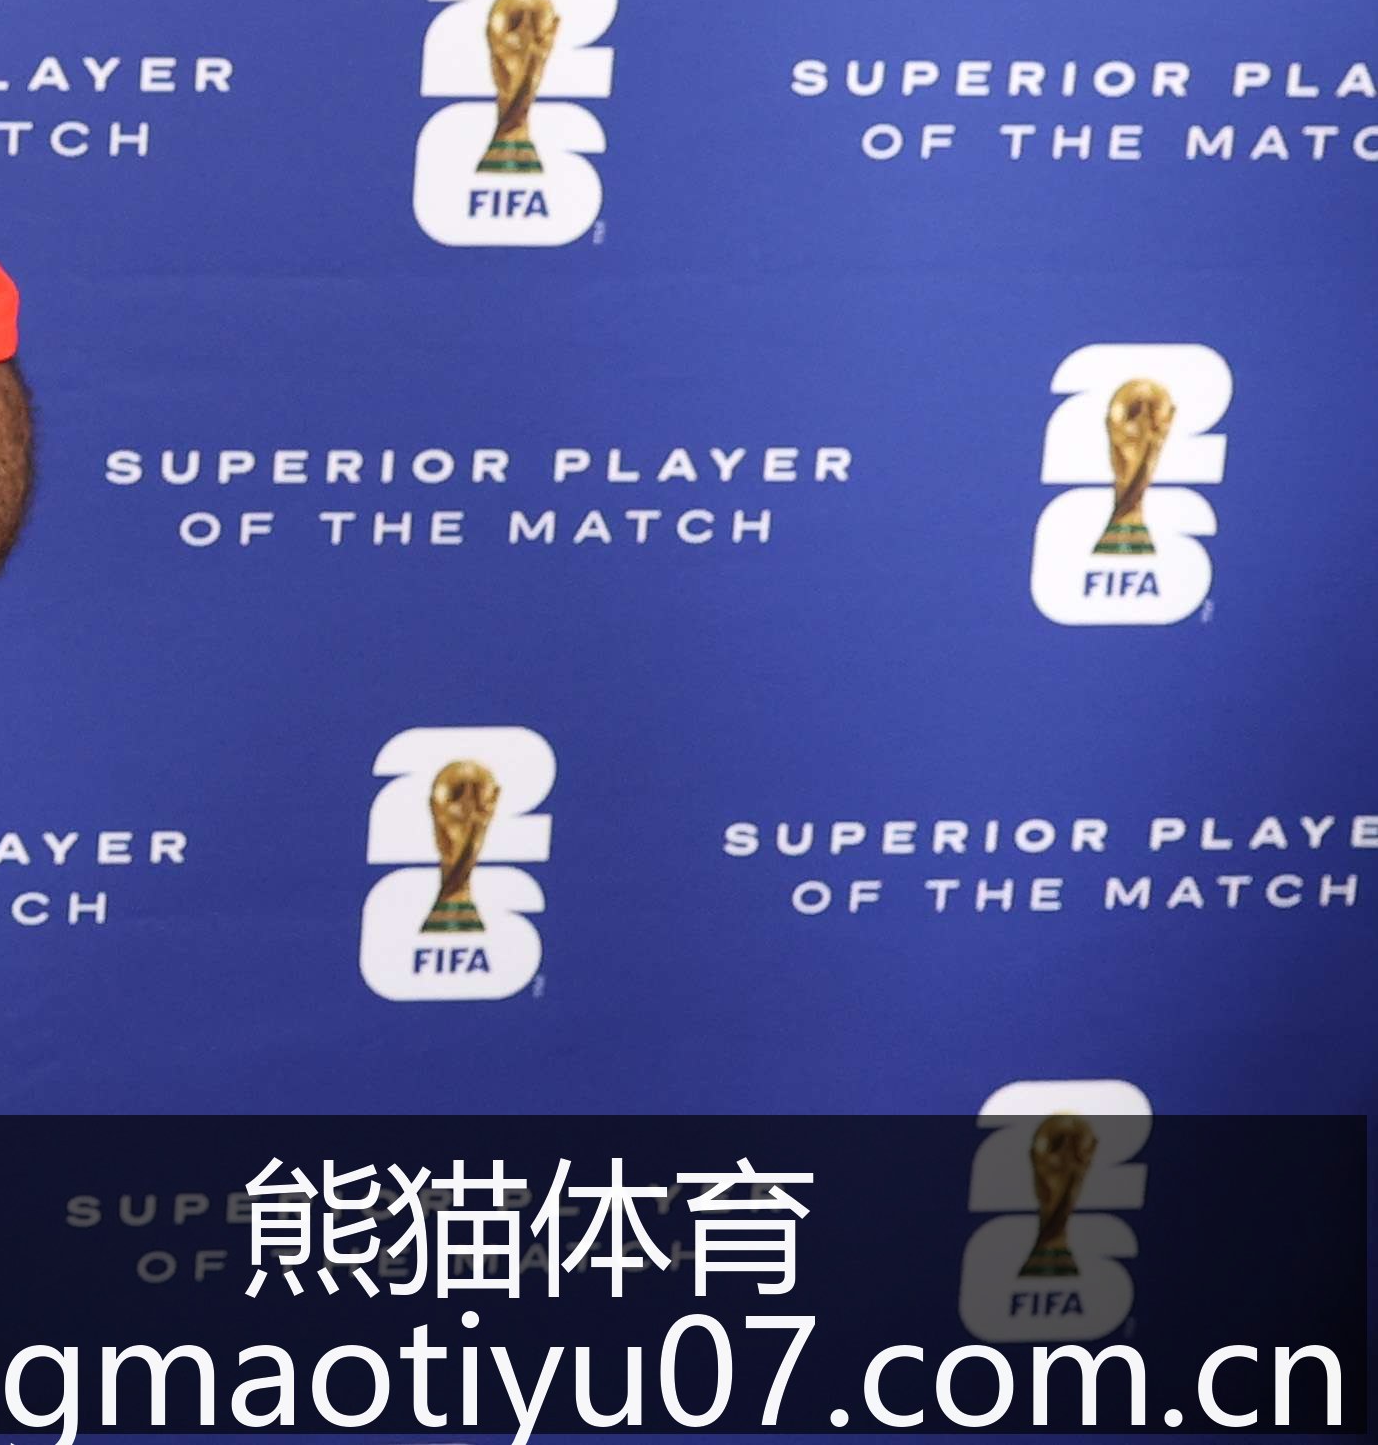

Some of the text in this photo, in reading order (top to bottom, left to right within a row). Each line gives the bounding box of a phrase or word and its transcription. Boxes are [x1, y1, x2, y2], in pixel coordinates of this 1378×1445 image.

[790, 59, 1377, 98] SUPERIOR PLA
[861, 123, 1378, 162] OF THE MATC
[467, 188, 550, 219] FIFA
[105, 446, 852, 486] SUPERIOR PLAYER
[179, 508, 772, 547] OF THE MATCH
[1083, 570, 1163, 601] FIFA
[722, 814, 1378, 857] SUPERIOR PLAYE
[791, 873, 1358, 916] OF THE MATCH
[412, 946, 491, 975] FIFA
[137, 1250, 228, 1282] OF
[1008, 1290, 1087, 1322] FIFA
